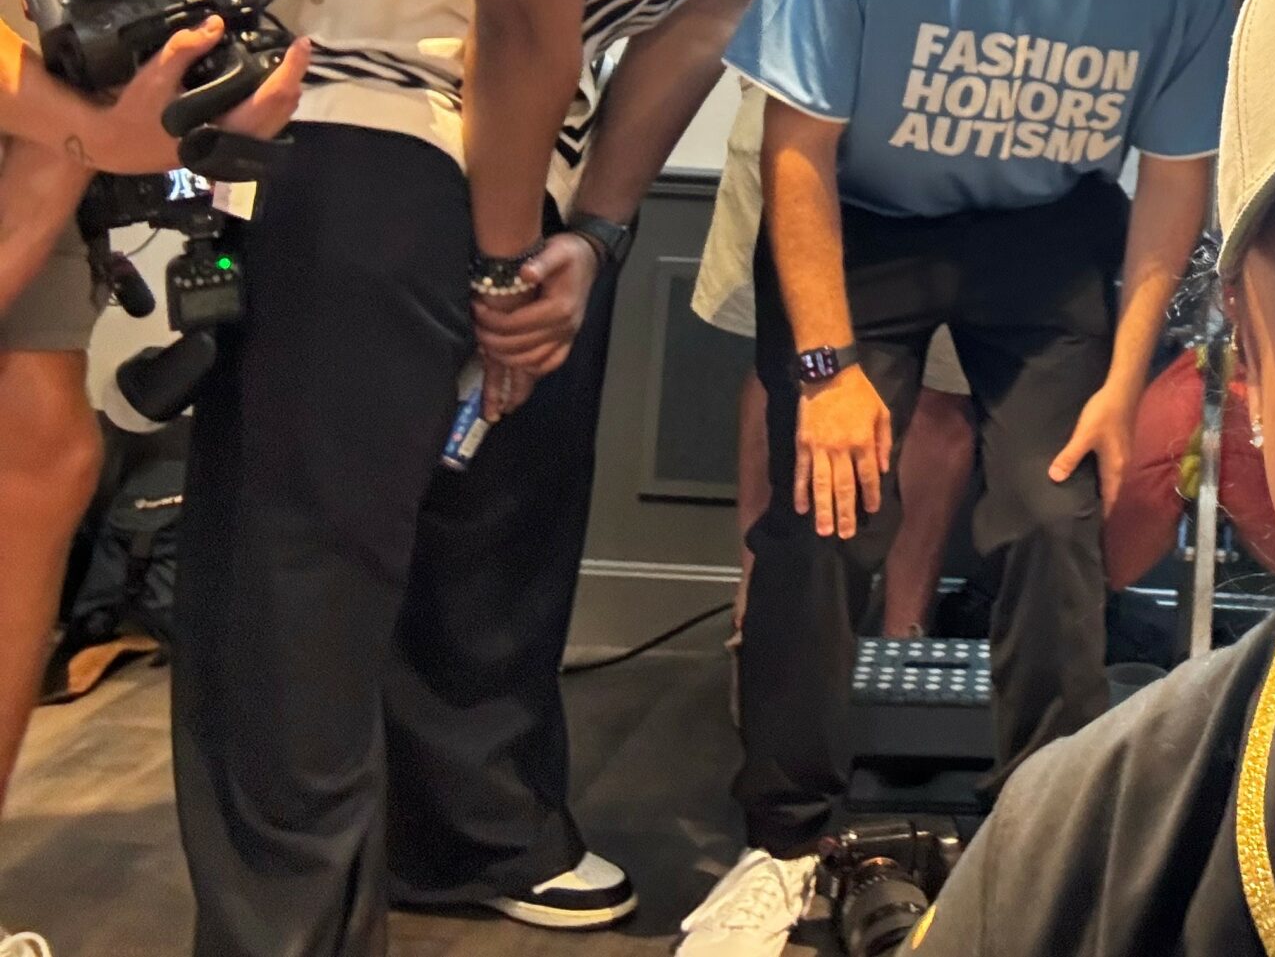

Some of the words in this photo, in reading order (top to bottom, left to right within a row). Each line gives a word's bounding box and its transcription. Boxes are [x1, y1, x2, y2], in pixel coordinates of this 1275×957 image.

[913, 22, 1140, 91] FASHION
[902, 68, 1126, 131] HONORS
[888, 111, 1091, 164] AUTISM
